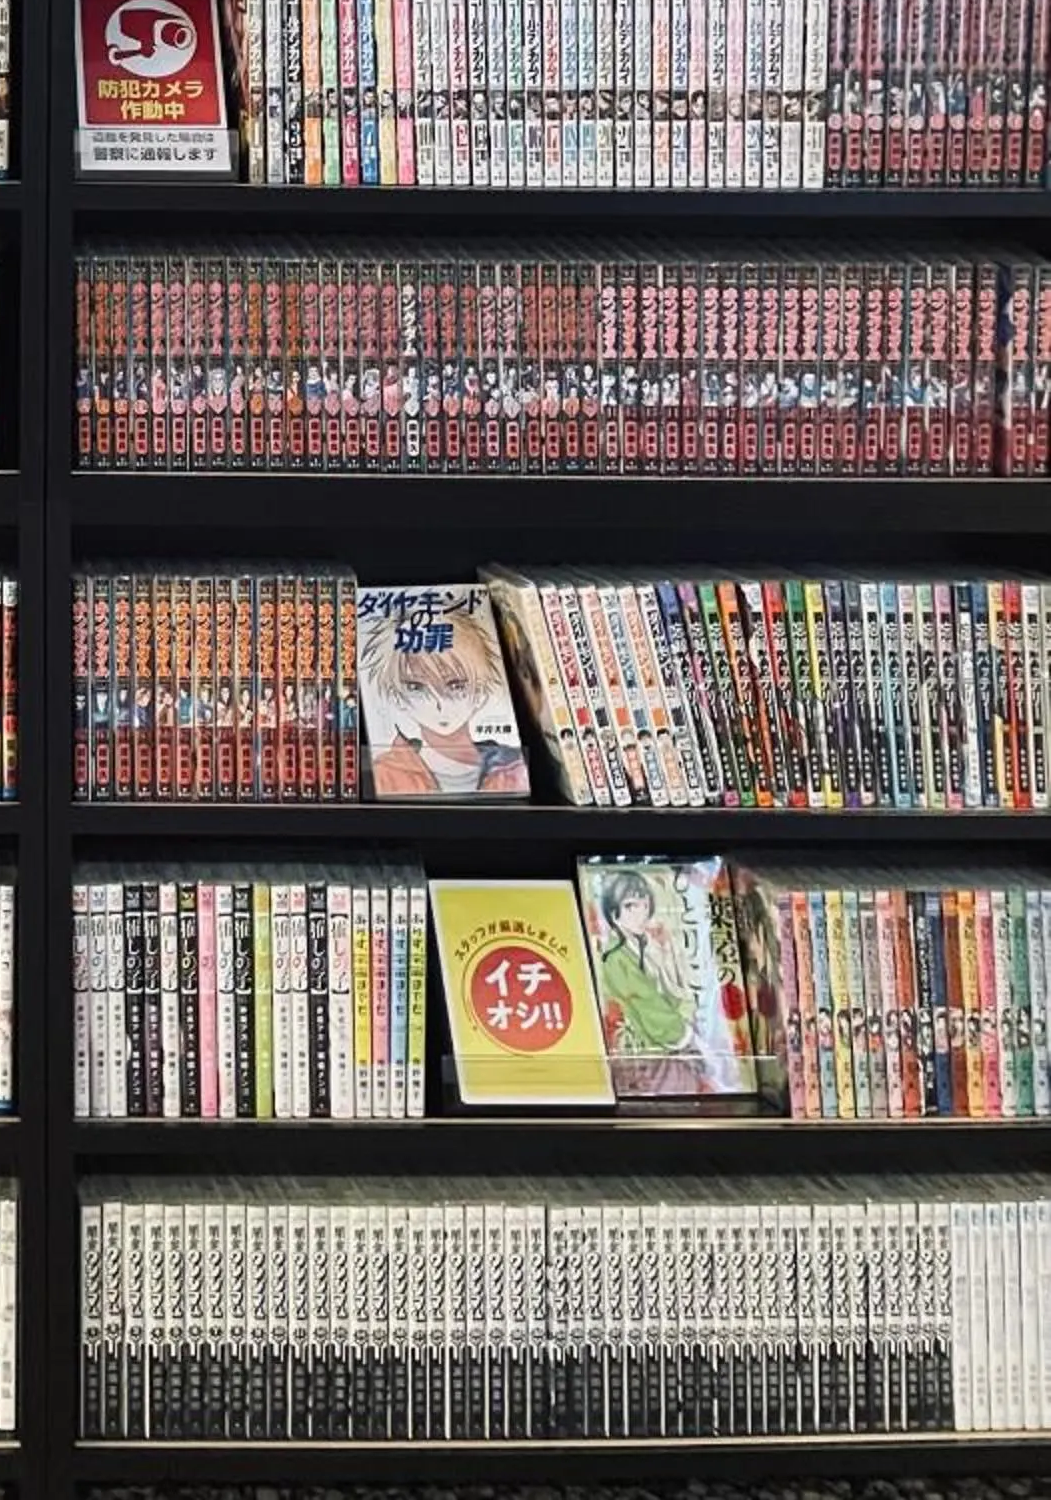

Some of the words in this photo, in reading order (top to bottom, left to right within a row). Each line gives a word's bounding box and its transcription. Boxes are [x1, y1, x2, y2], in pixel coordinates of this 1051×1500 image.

[98, 80, 204, 98] 防犯カメラ
[120, 101, 185, 120] 作動中
[94, 148, 218, 161] 警察に通報します
[358, 591, 488, 618] ダイヤモンド
[411, 608, 433, 628] の
[395, 624, 453, 652] 功罪
[485, 960, 552, 996] イチ
[486, 1000, 563, 1030] オシ!!
